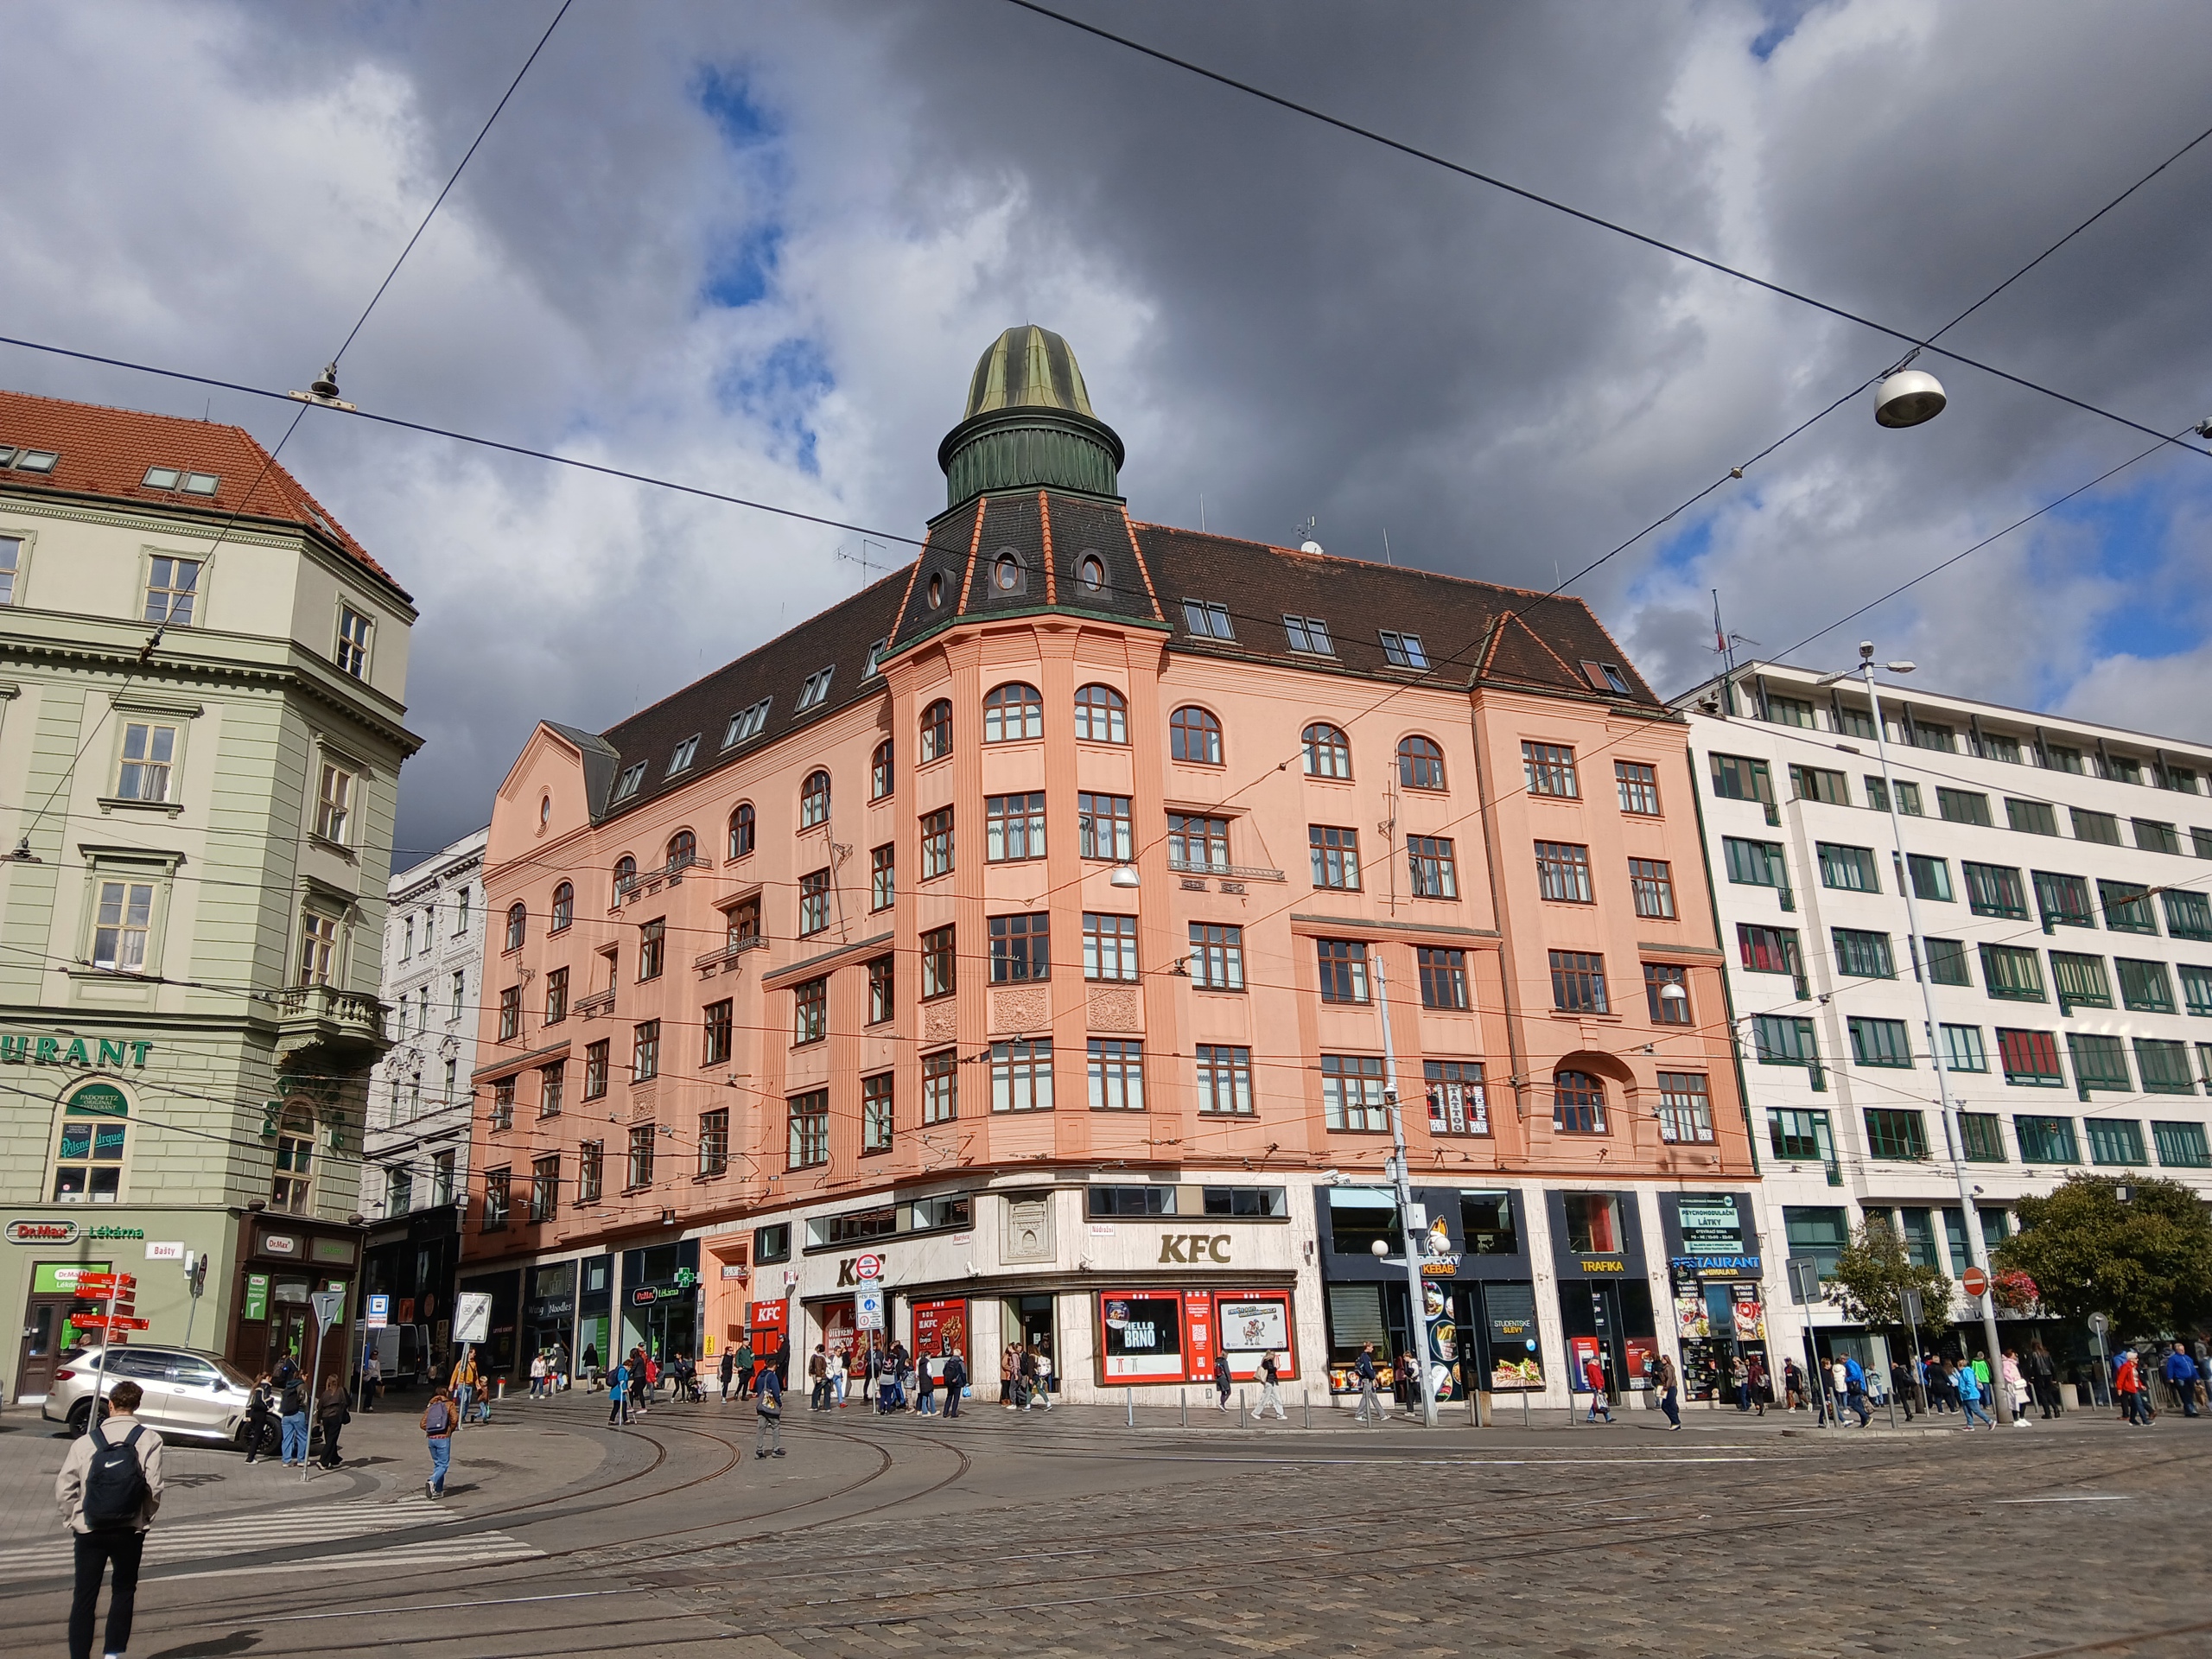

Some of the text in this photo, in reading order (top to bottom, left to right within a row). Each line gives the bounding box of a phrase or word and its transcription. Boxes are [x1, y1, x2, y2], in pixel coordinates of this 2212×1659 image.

[0, 1035, 153, 1069] URANT
[1450, 1087, 1463, 1131] TATTOO
[1472, 1085, 1487, 1121] PIERCING
[60, 1130, 124, 1159] Pilsne Urquel
[1698, 1217, 1721, 1226] LÁTKY
[17, 1225, 144, 1239] Dr.Max Lékárna
[154, 1246, 175, 1256] Bašty
[269, 1239, 289, 1249] Dr.Max
[1158, 1234, 1231, 1263] KFC
[1422, 1264, 1455, 1274] KEBAB
[1580, 1261, 1624, 1272] TRAFIKA
[1705, 1268, 1739, 1276] HIMALAYA
[528, 1301, 572, 1316] Wang Noodles
[757, 1306, 780, 1322] KFC
[1124, 1321, 1154, 1330] HELLO
[1124, 1330, 1156, 1348] BRNO
